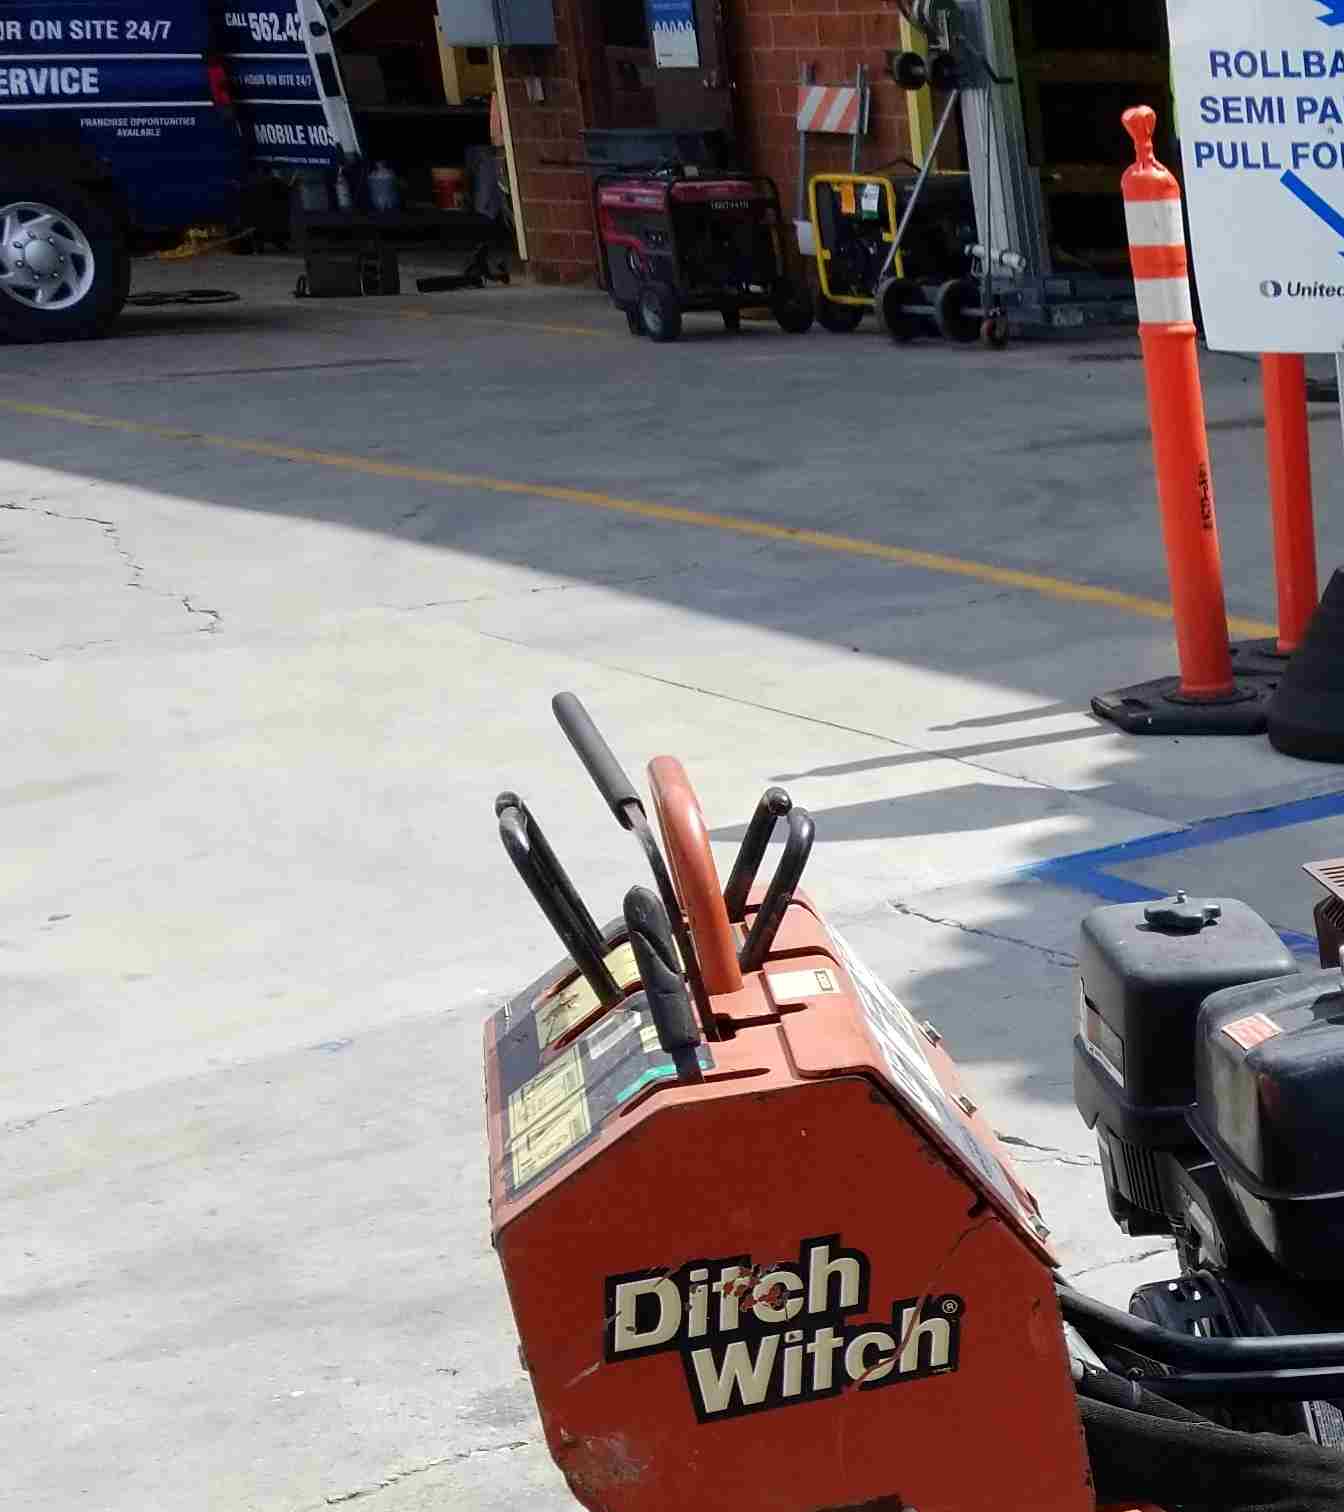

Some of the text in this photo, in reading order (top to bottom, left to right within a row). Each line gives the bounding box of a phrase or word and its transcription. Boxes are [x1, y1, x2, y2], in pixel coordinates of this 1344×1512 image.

[30, 19, 62, 40] ON
[69, 19, 119, 40] SITE
[125, 19, 172, 42] 24/7
[225, 12, 248, 27] CALL
[1199, 95, 1287, 125] SEMI
[115, 127, 161, 137] AVAILABLE
[255, 123, 307, 145] MOBILE
[1193, 141, 1282, 169] PULL
[613, 1243, 861, 1352] Ditch
